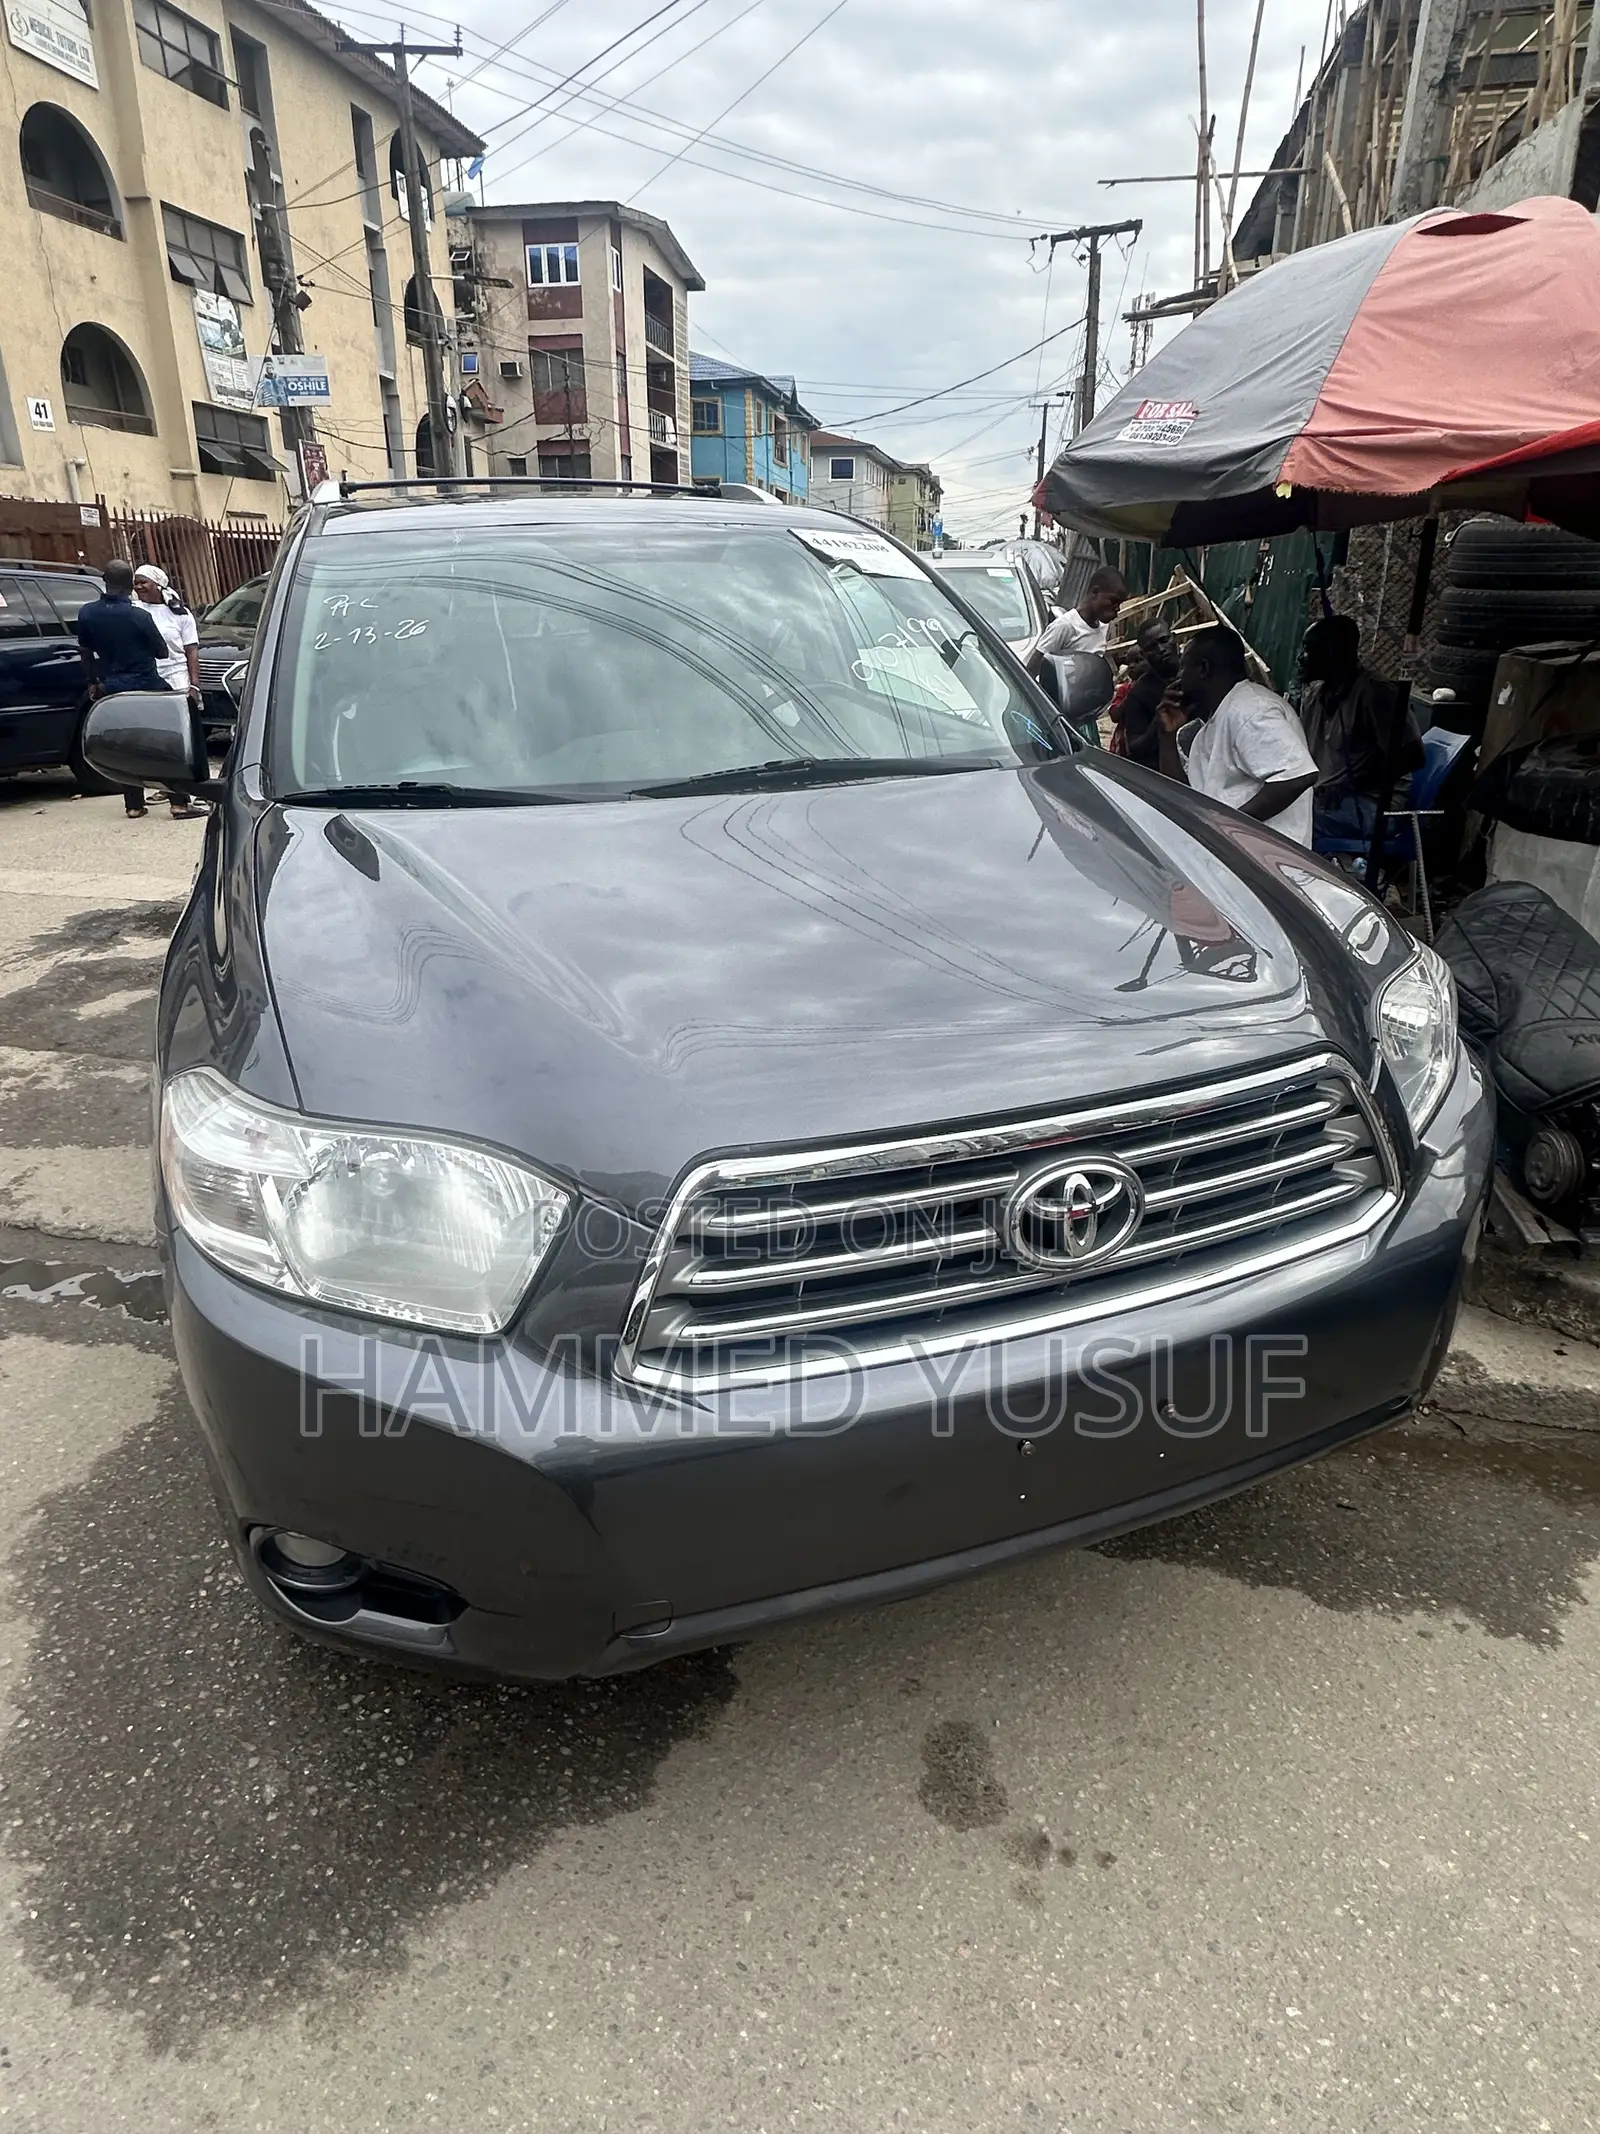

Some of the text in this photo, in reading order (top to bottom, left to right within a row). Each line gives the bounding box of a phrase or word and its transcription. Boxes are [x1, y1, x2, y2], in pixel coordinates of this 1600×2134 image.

[288, 381, 327, 391] OSHILE
[34, 402, 49, 419] 41
[1138, 401, 1170, 419] FOR
